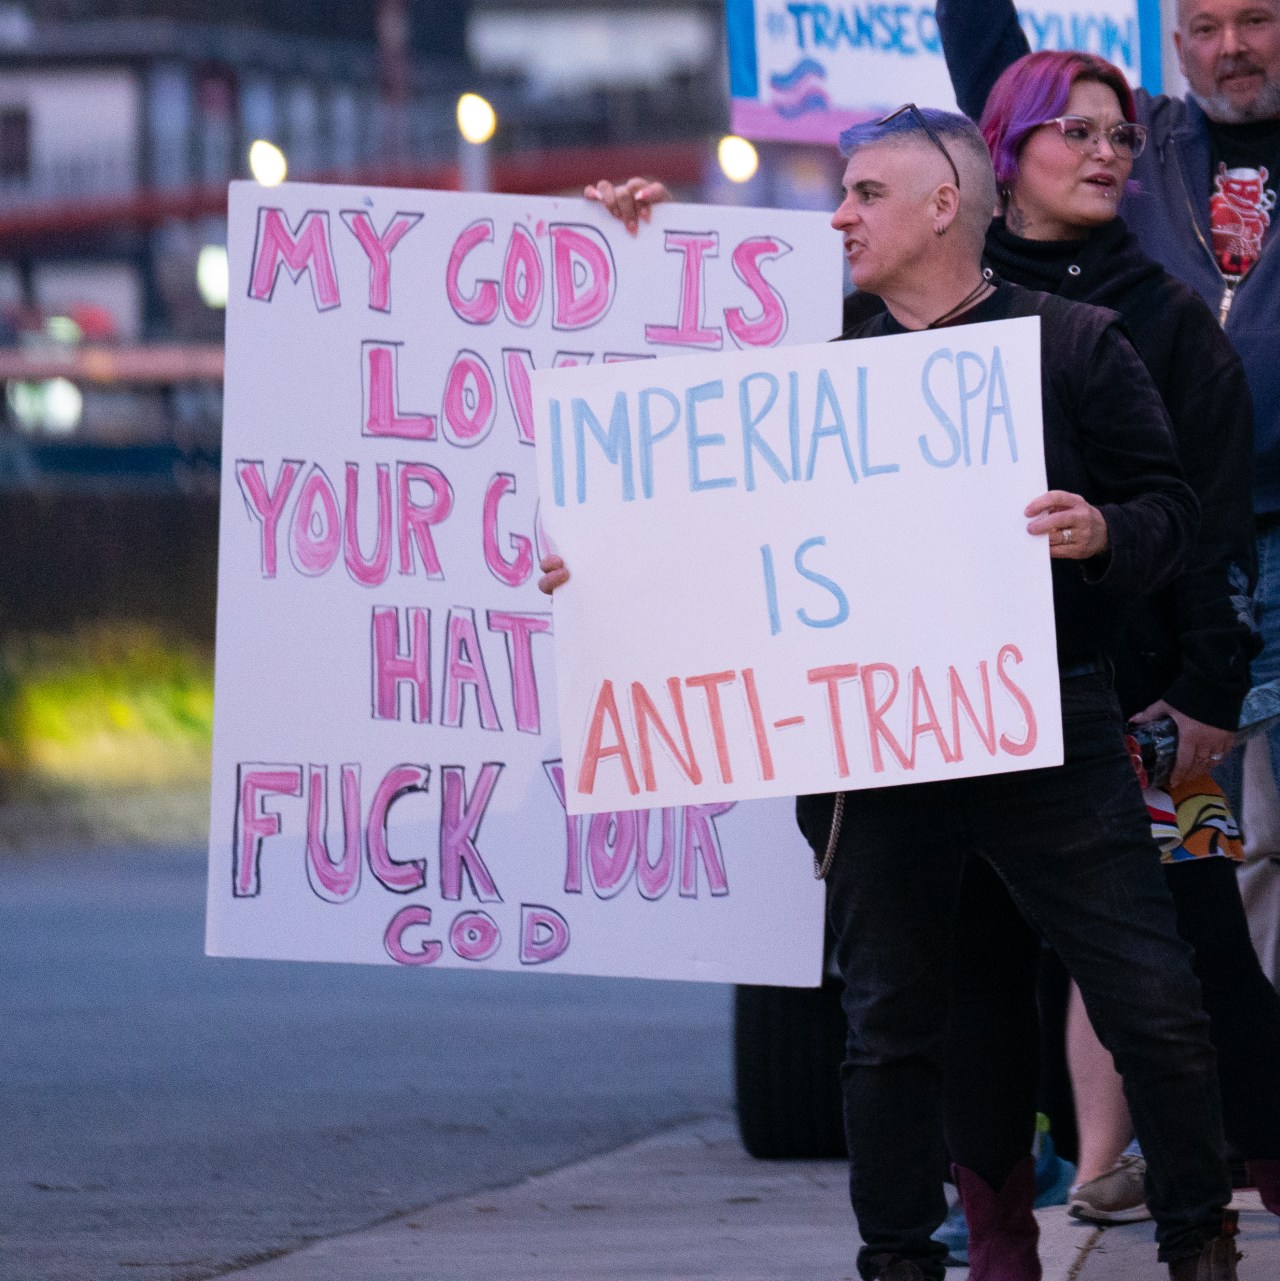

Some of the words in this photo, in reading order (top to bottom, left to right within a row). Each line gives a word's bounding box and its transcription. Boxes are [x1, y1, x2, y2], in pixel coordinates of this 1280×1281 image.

[248, 207, 424, 313] MY
[446, 219, 617, 331] GOD
[645, 229, 793, 352] IS
[361, 340, 655, 448] LOV
[549, 366, 899, 507] IMPERIAL
[918, 345, 1020, 467] SPA
[236, 459, 455, 587] YOUR
[759, 535, 850, 636] IS
[372, 605, 553, 735] HAT
[577, 644, 1039, 797] ANTI-TRANS
[233, 762, 505, 903] FUCK
[542, 758, 739, 901] YOUR
[383, 903, 570, 966] GOD
